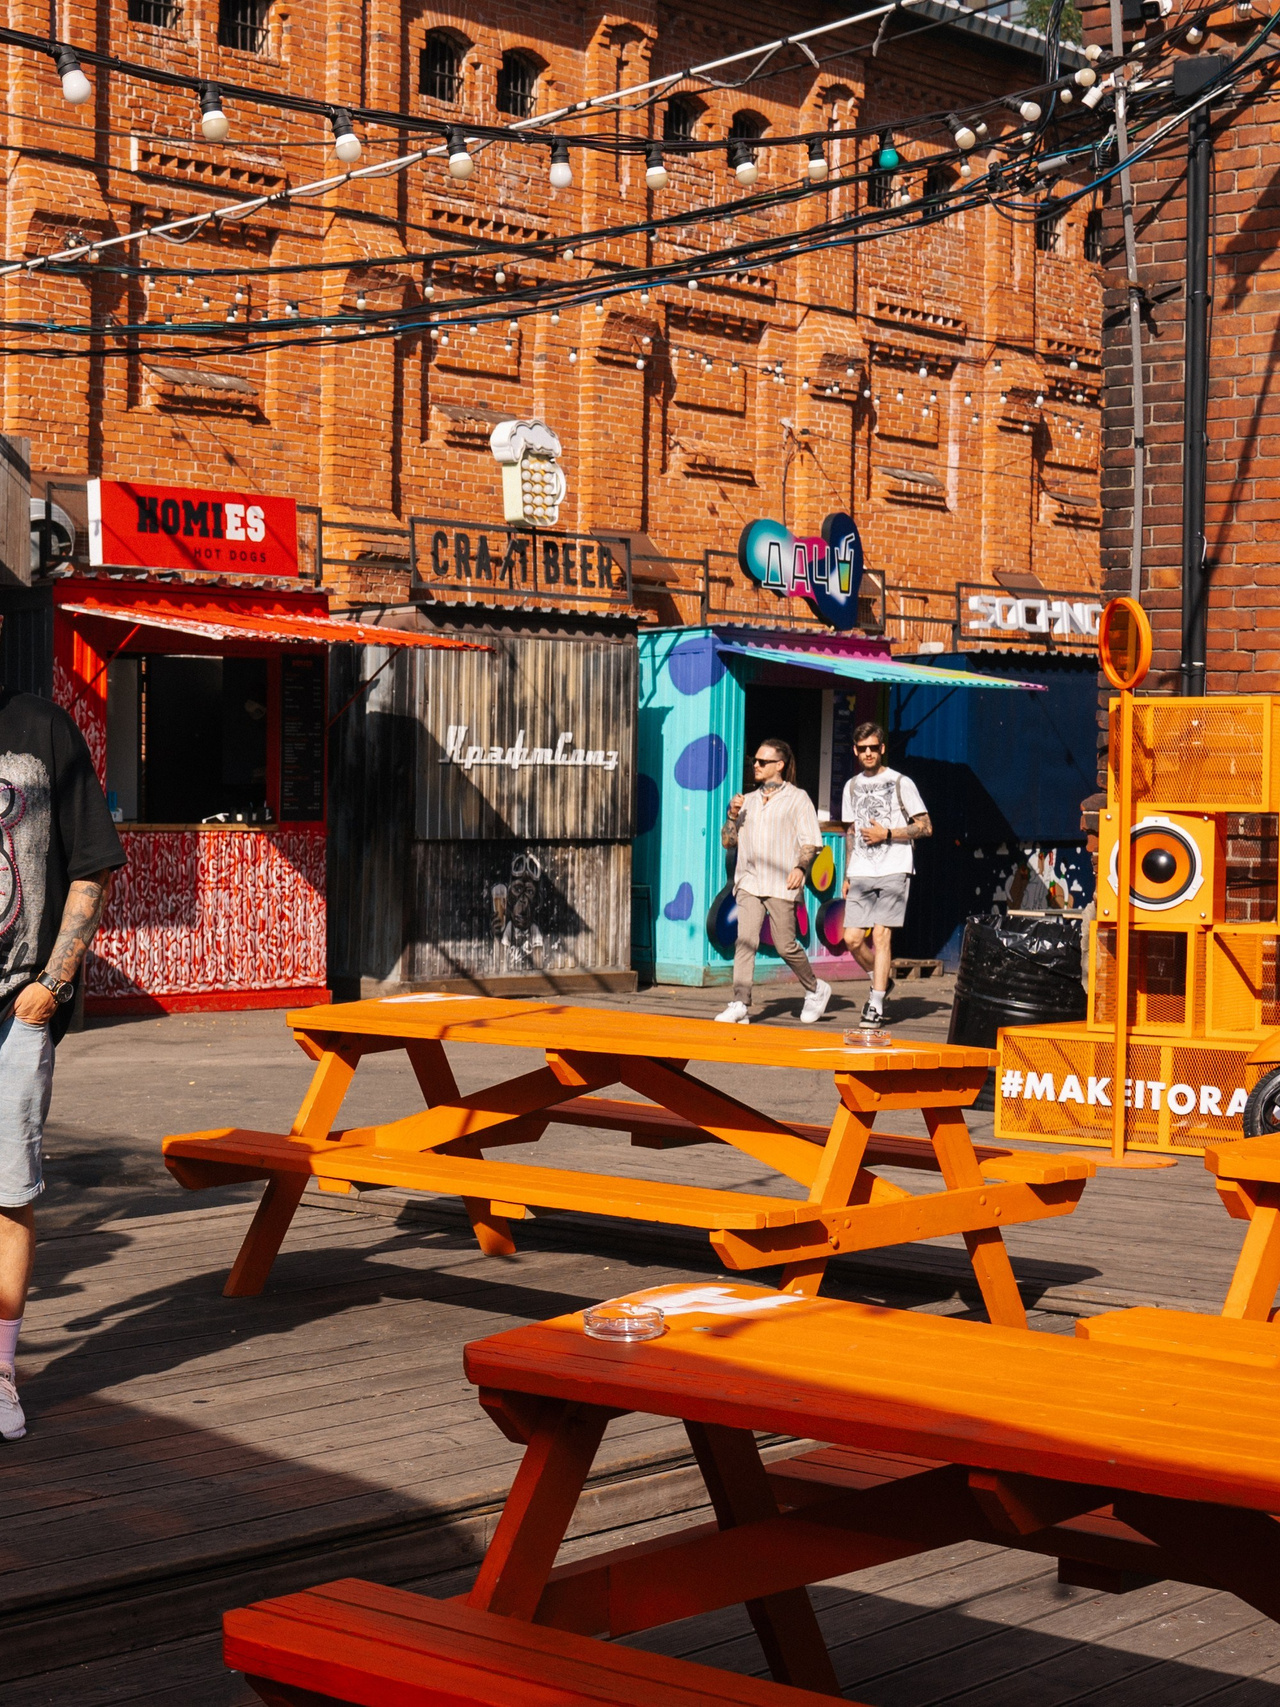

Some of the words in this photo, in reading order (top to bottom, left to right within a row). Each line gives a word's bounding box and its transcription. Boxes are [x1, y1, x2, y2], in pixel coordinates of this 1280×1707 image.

[137, 496, 266, 543] HOMIES
[194, 549, 220, 560] HOT
[229, 551, 267, 563] DOGS
[542, 540, 614, 589] BEER
